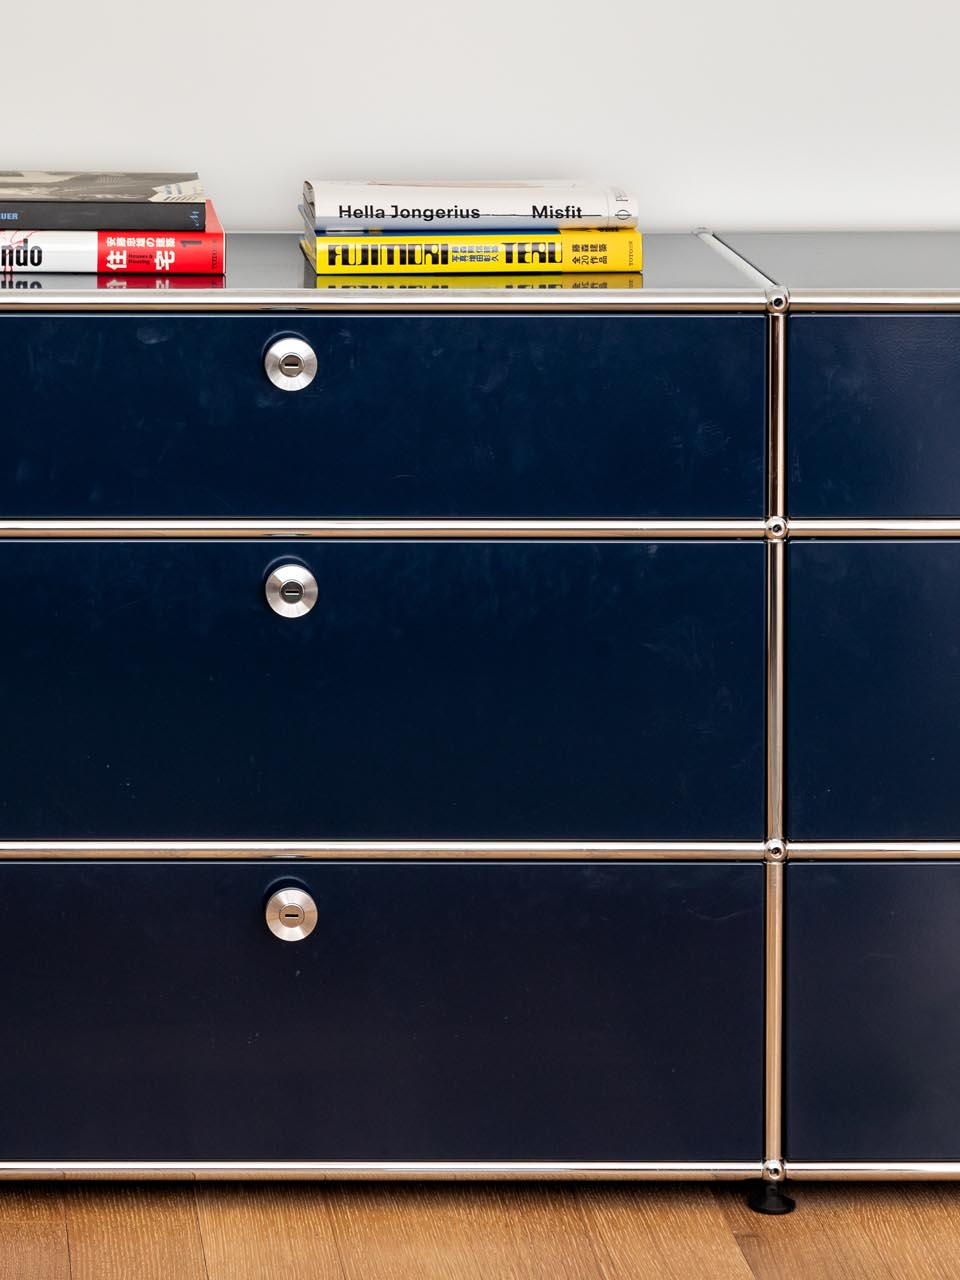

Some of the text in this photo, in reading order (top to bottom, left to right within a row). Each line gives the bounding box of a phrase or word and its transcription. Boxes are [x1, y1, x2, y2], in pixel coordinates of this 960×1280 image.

[338, 204, 583, 222] Hella Jongerius Misfit
[328, 243, 449, 266] FUJIMORI
